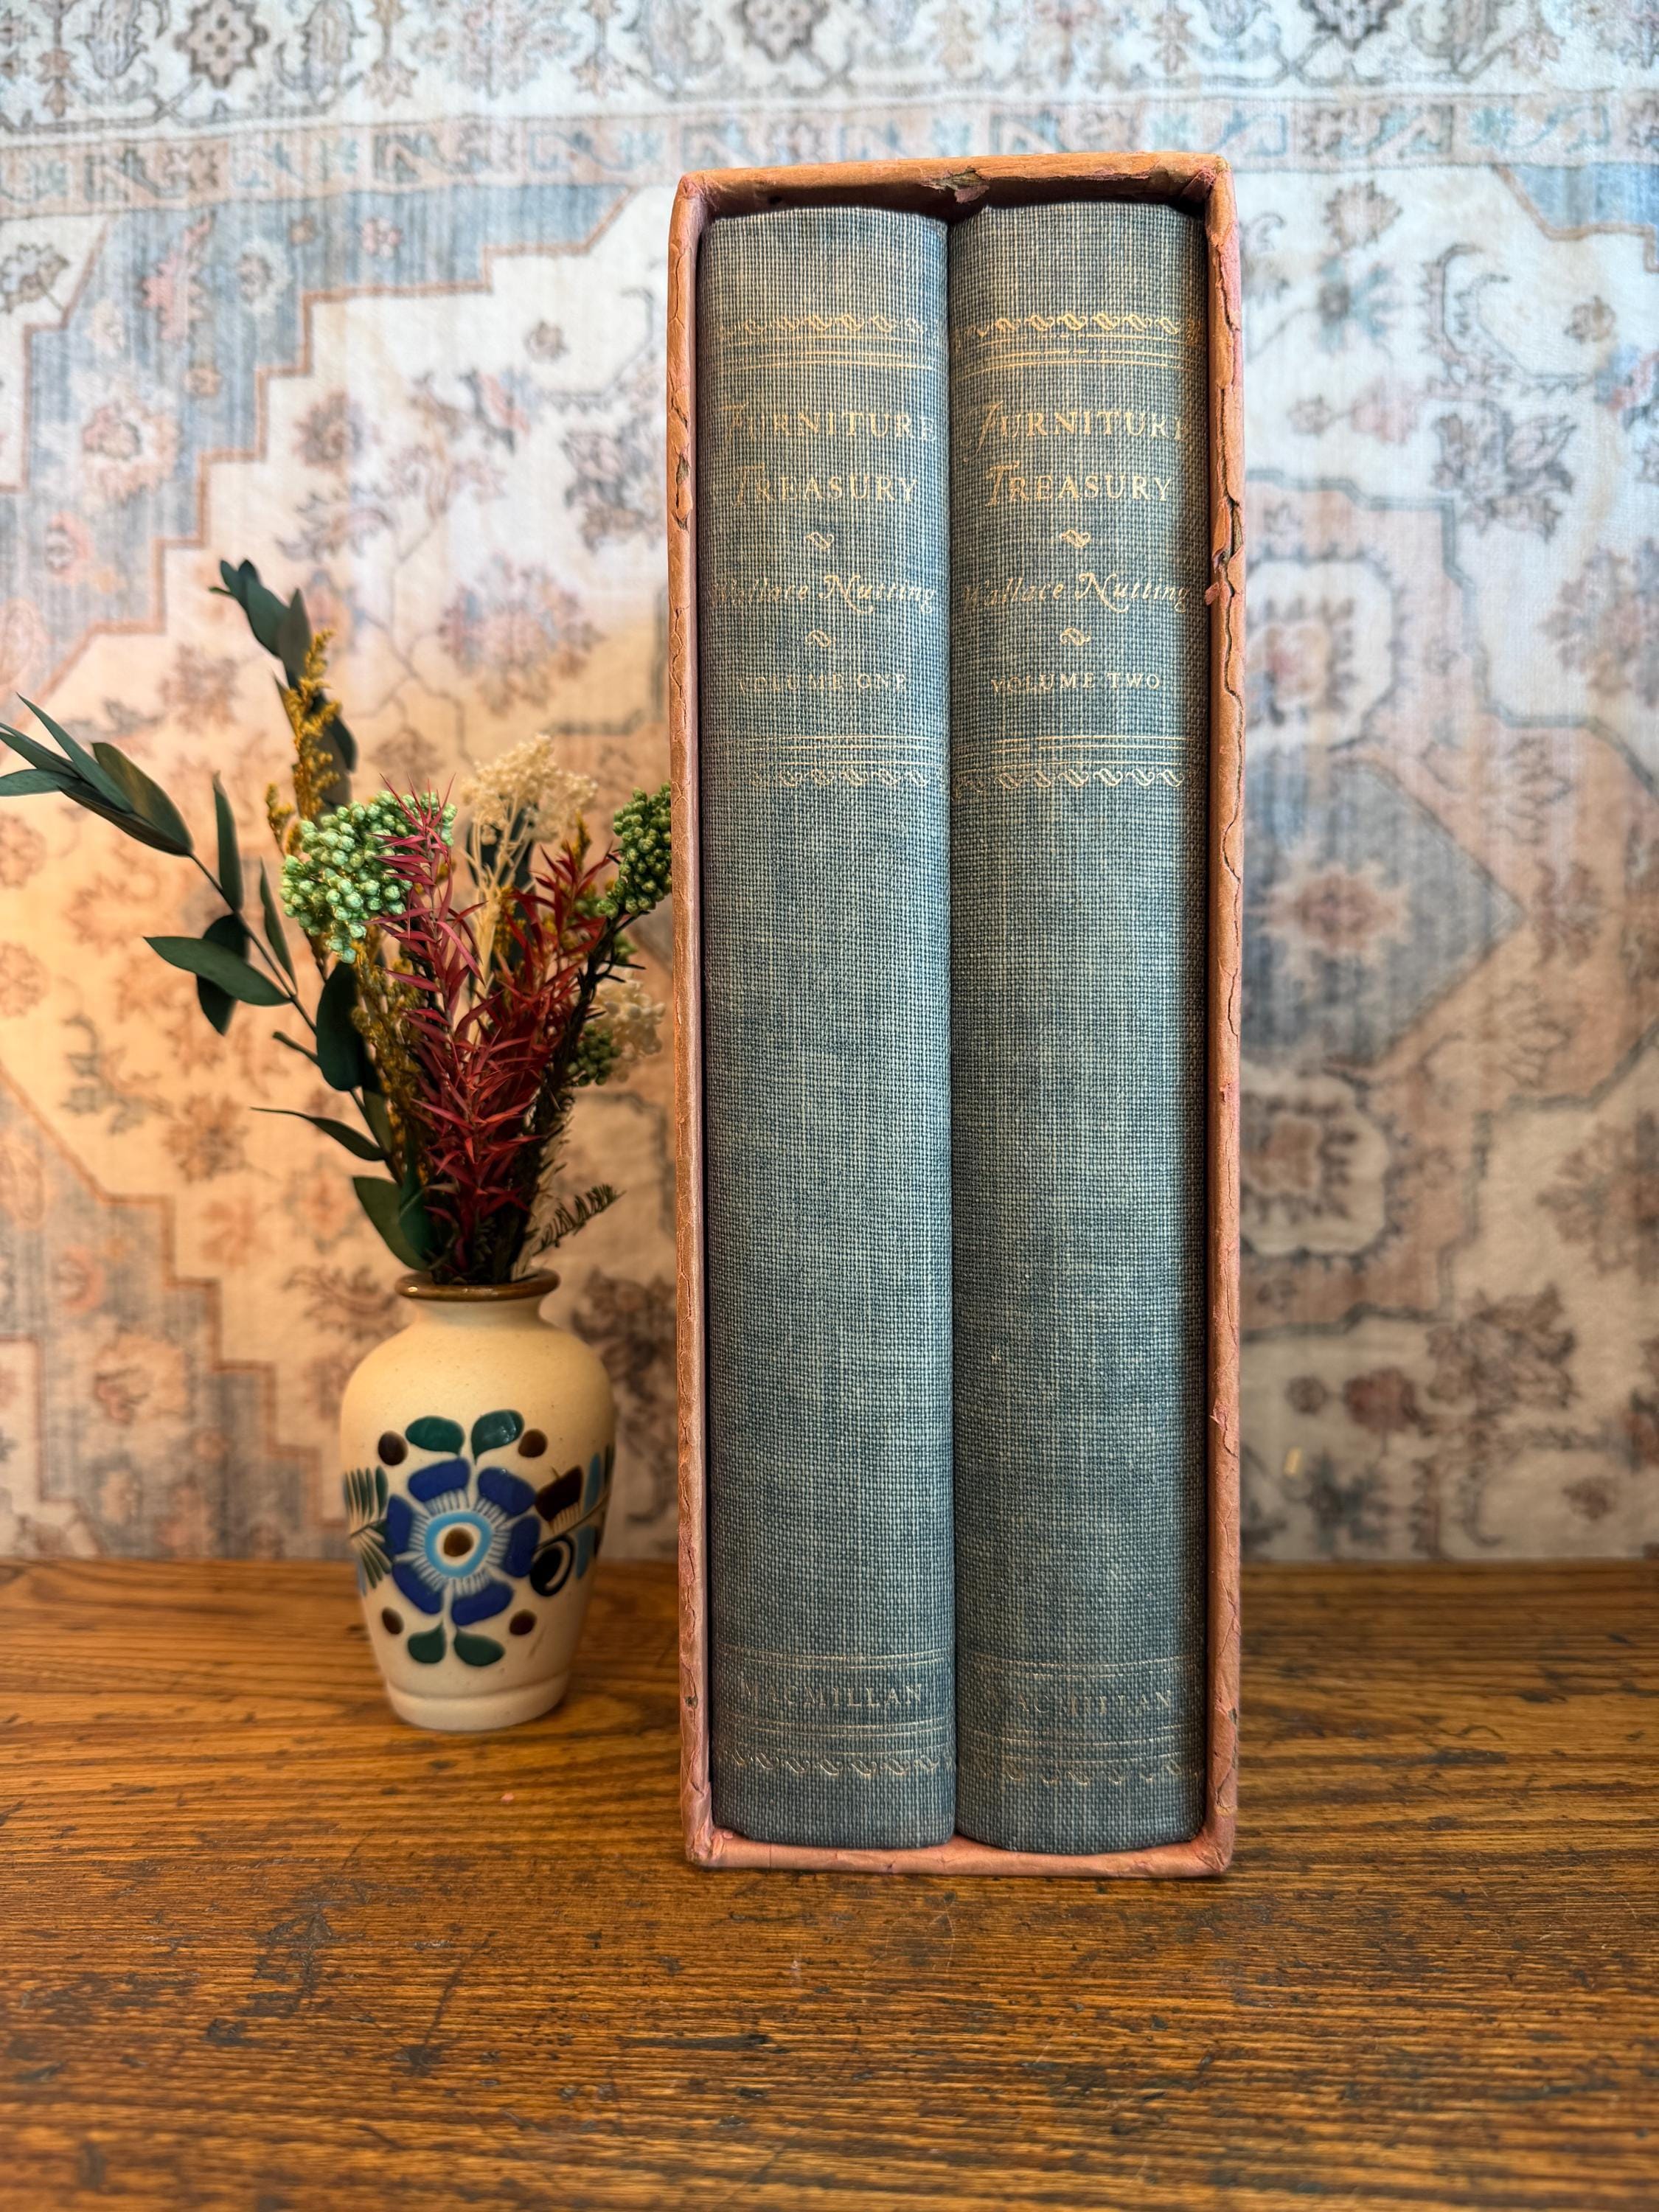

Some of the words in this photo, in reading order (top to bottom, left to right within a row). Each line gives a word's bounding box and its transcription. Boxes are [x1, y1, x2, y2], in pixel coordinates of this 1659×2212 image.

[733, 462, 918, 507] TREASURY
[984, 460, 1172, 507] TREASURY
[818, 574, 937, 614] Nutting
[1075, 572, 1191, 613] Nutting
[738, 672, 844, 694] VOLUME
[857, 672, 905, 691] ONE
[990, 672, 1096, 693] VOLUME
[1107, 672, 1161, 690] TWO
